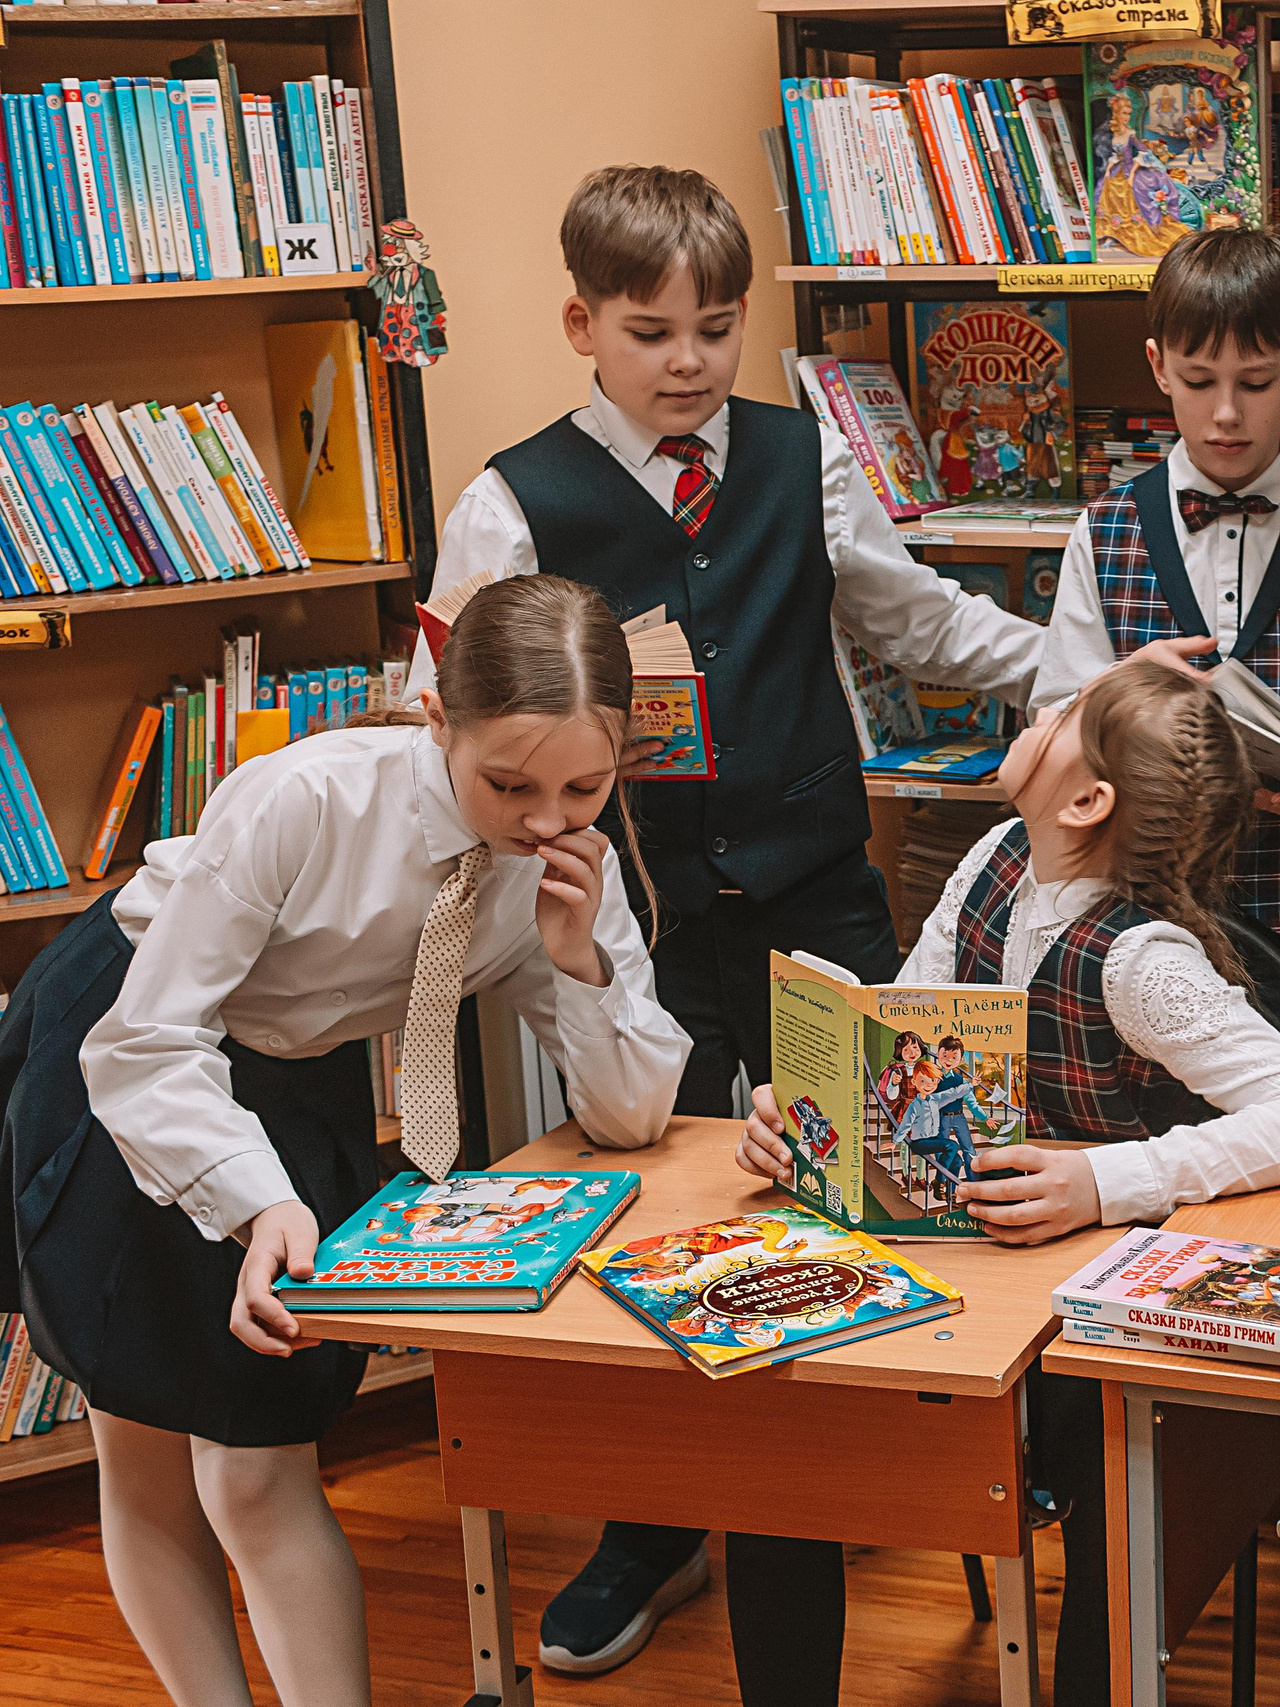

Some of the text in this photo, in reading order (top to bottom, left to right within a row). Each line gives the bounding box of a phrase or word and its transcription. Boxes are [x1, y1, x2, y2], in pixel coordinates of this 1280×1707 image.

[1116, 9, 1188, 28] страна
[321, 92, 334, 137] ЖИВОТНЫХ
[51, 115, 67, 154] КОРОЛЕЙ
[75, 125, 87, 157] ЗЕМЛИ
[90, 112, 119, 233] СЕМЬ ПОДЗЕМНЫХ КОРОЛЕЙ
[152, 164, 162, 192] ТУМАН
[327, 148, 340, 191] РАССКАЗЫ
[348, 100, 370, 228] РАССКАЗЫ ДЛЯ ДЕТЕЙ
[888, 127, 913, 214] СКАЗКИ РУССКИХ ПИСАТЕЛЕЙ
[1070, 160, 1082, 193] ЧТЕНИЕ
[60, 157, 78, 211] ПОДЗЕМНЫХ
[81, 175, 97, 217] ДЕВОЧКА
[961, 159, 993, 256] ВНЕКЛАССНОЕ ЧТЕНИЕ
[70, 214, 82, 236] СЕМЬ
[77, 240, 88, 275] А.ВОЛКОВ
[114, 238, 125, 273] А.ВОЛКОВ
[194, 234, 205, 268] А.ВОЛКОВ
[285, 238, 319, 260] Ж
[998, 269, 1153, 290] Детская литератур
[921, 310, 1065, 369] КОШКИН
[957, 353, 1032, 388] ДОМ
[863, 389, 894, 405] 100
[54, 430, 72, 460] ЧУДЕС
[71, 461, 94, 496] СТРАНЕ
[864, 465, 884, 496] 100
[93, 507, 114, 536] АЛИСА
[259, 477, 307, 561] БАСНИ КРЫЛОВА
[910, 533, 934, 541] КЛАСС
[879, 998, 1023, 1018] Стёпка, Галёныч
[933, 1020, 1013, 1042] и Машуня
[936, 1213, 986, 1231] Салома
[329, 1259, 518, 1272] СКАЗКИ
[361, 1248, 491, 1258] ЖИВОТНЫХ
[1120, 1249, 1171, 1280] СКАЗКИ
[1125, 1239, 1211, 1299] БРАТЬЕВ ГРИММ
[309, 1271, 519, 1284] РУССКИЕ
[719, 1264, 835, 1299] Сказки
[731, 1273, 844, 1308] волшебные
[754, 1285, 841, 1312] Русские
[1073, 1306, 1093, 1317] КЛАССИКА
[1084, 1332, 1106, 1341] КЛАССИКА
[1128, 1309, 1275, 1345] СКАЗКИ БРАТЬЕВ ГРИММ
[1163, 1336, 1229, 1353] ХАЙДИ
